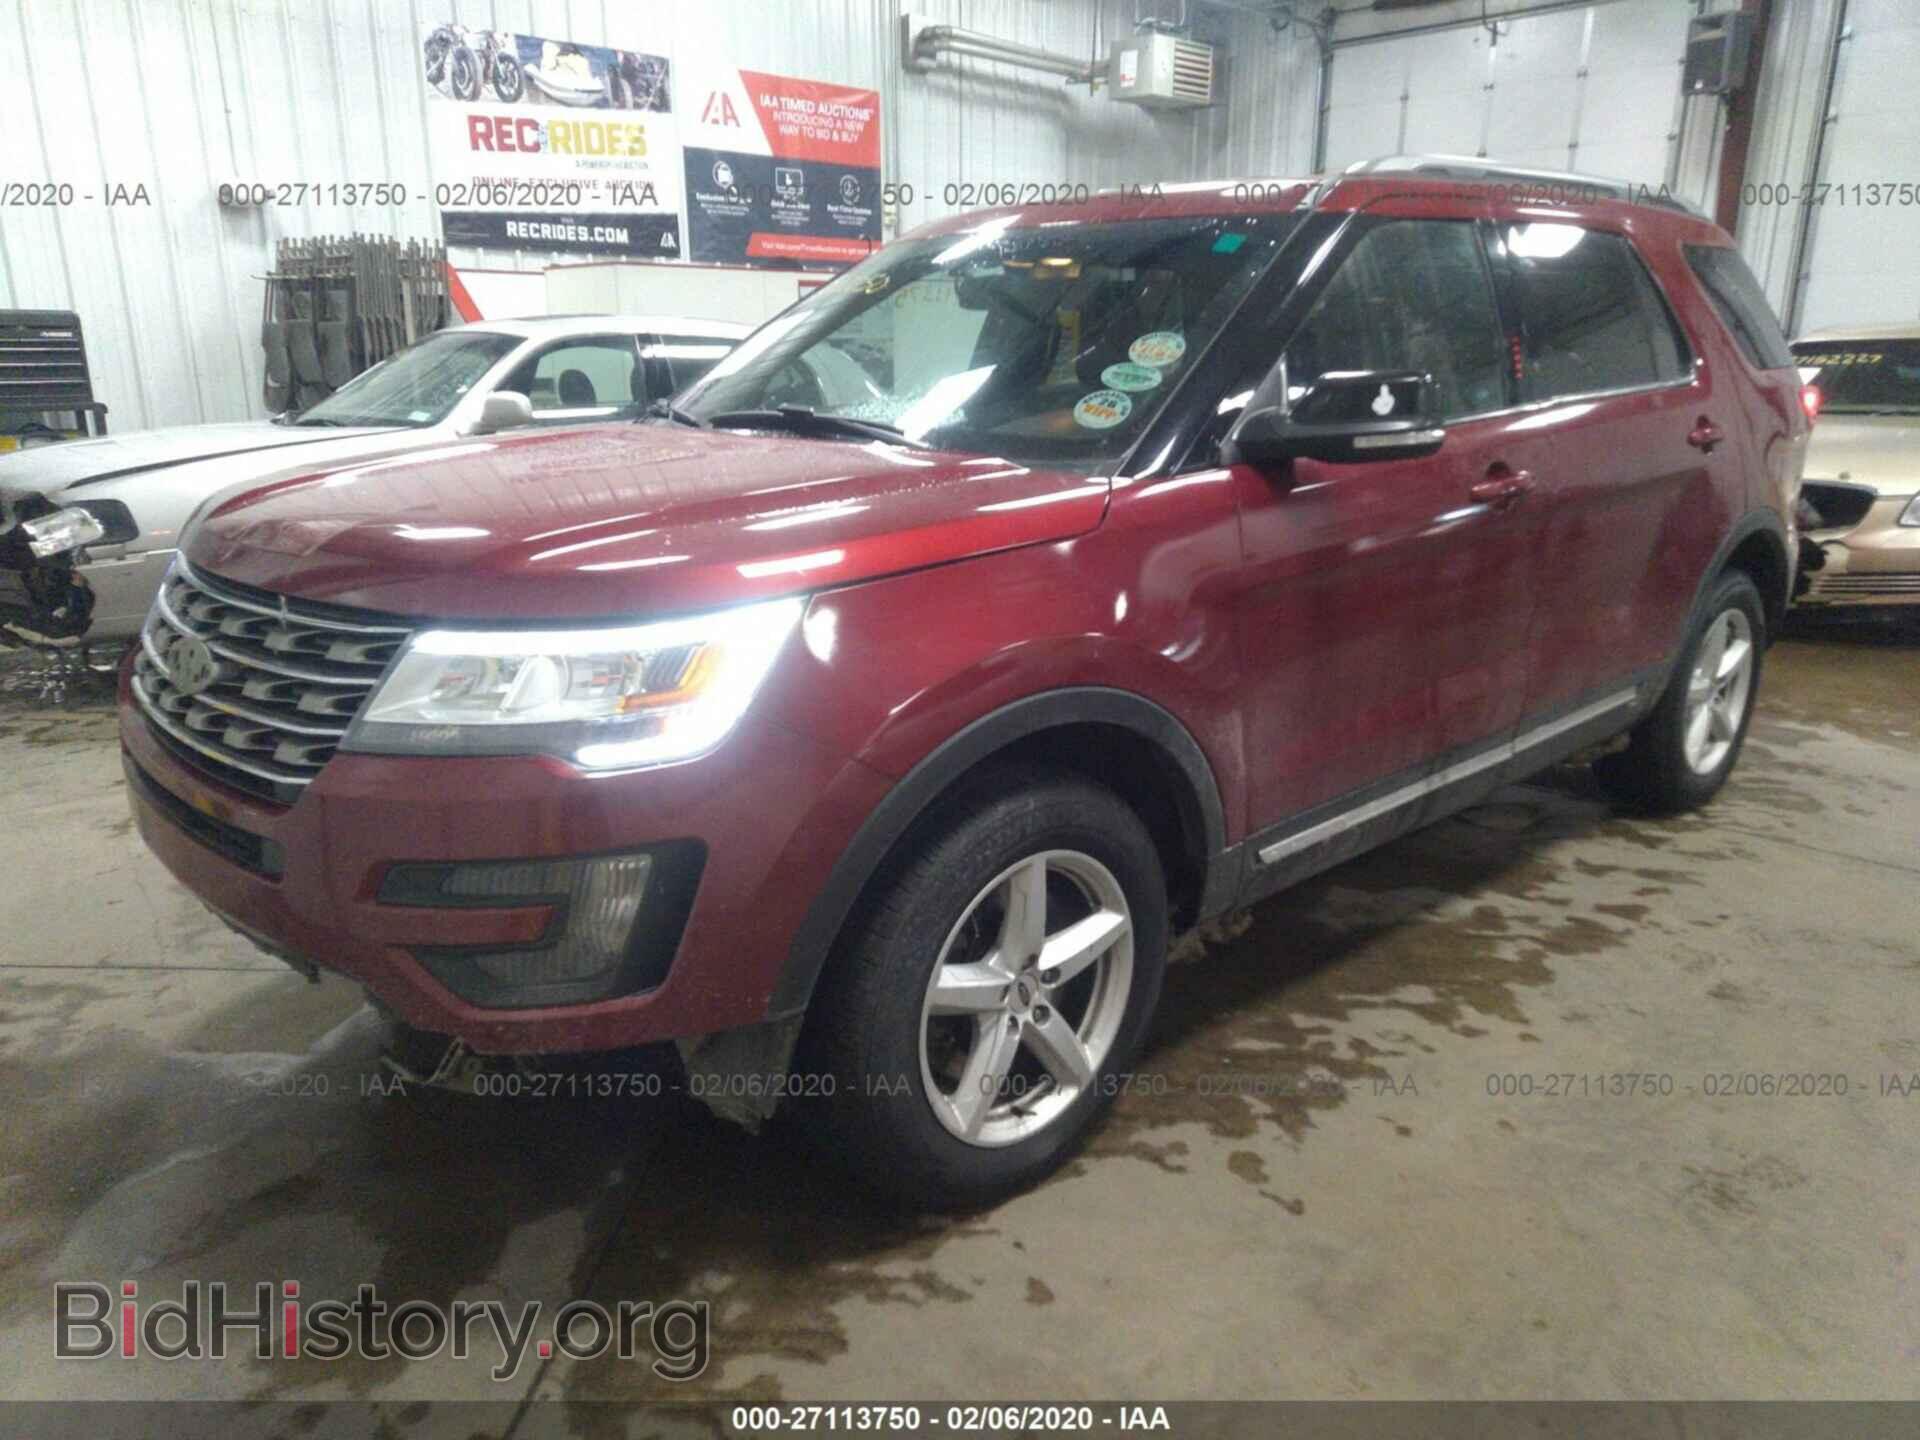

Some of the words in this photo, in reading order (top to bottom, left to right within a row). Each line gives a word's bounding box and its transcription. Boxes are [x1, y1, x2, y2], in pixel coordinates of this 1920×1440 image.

[760, 93, 779, 108] IAA
[780, 97, 815, 114] TIMED
[773, 111, 834, 129] INTRODUCING
[836, 119, 842, 128] A
[844, 120, 864, 132] NEW
[467, 115, 541, 154] REC
[547, 119, 648, 156] RIDES
[779, 125, 799, 136] WAY
[801, 126, 815, 138] TO
[816, 129, 830, 139] BID
[841, 131, 859, 143] BUY
[505, 220, 629, 244] RECRIDES.COM
